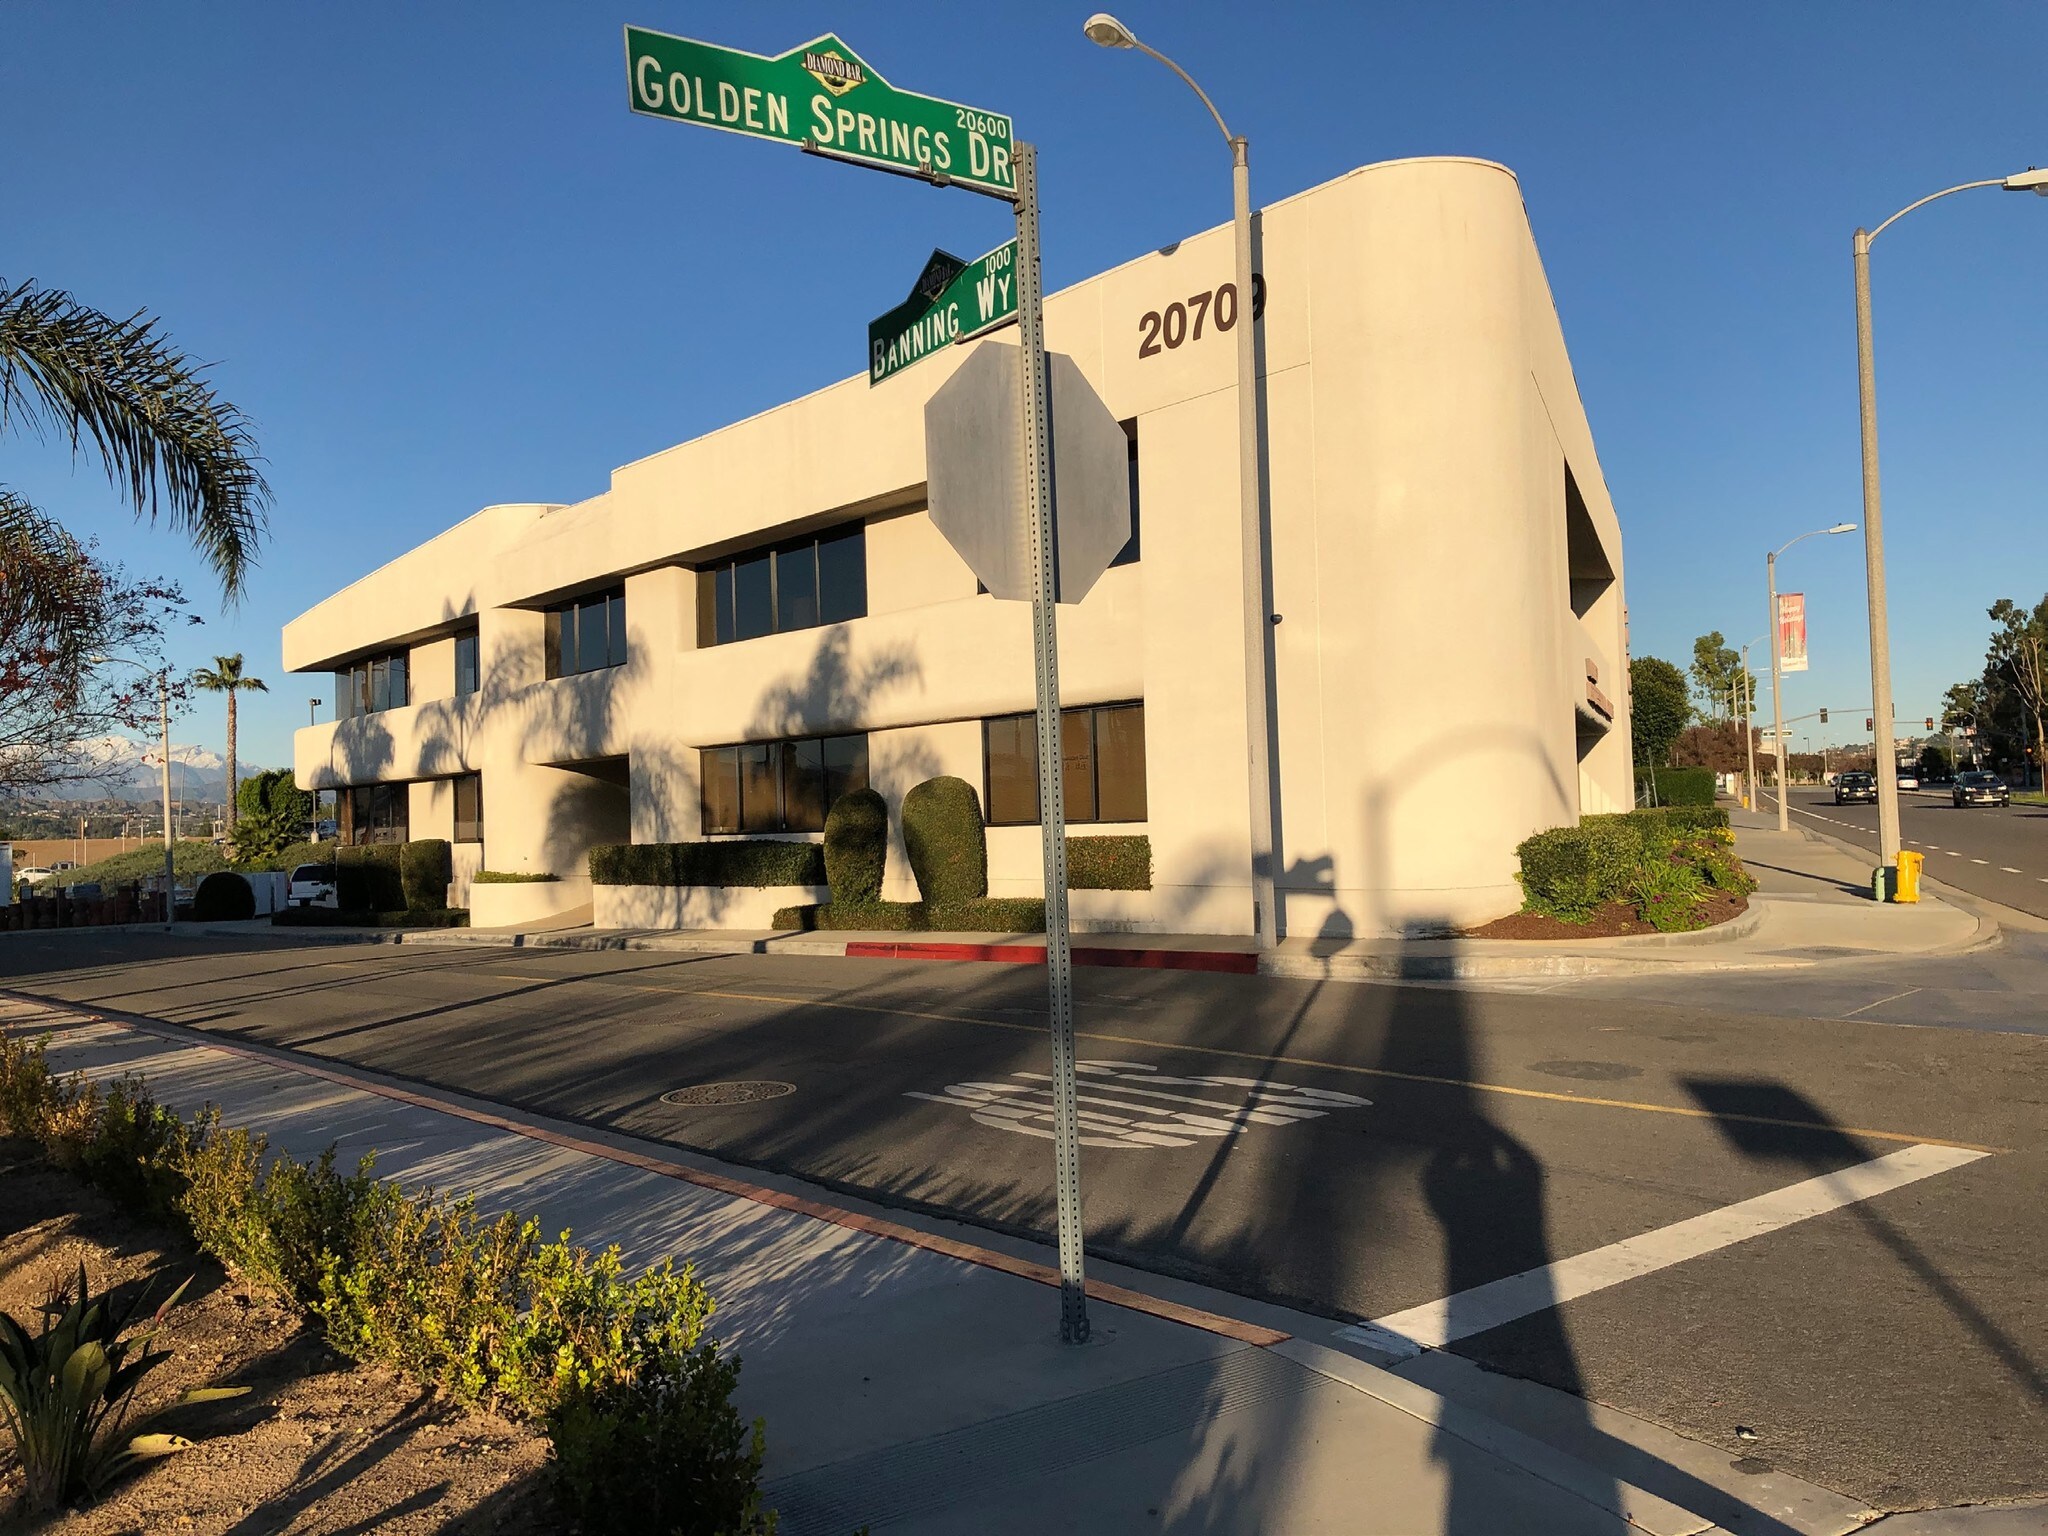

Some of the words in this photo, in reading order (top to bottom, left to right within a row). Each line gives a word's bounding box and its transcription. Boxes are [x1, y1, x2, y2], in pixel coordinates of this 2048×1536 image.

[806, 53, 845, 77] DIAMOND
[845, 62, 862, 81] BAR
[636, 55, 789, 135] GOLDEN
[811, 95, 951, 170] SPRINGS
[968, 132, 1012, 184] DR
[956, 108, 1007, 139] 20600
[985, 247, 1011, 276] 1000
[873, 302, 959, 380] BANNING
[976, 273, 1011, 322] WY
[901, 1059, 1375, 1149] STOP
